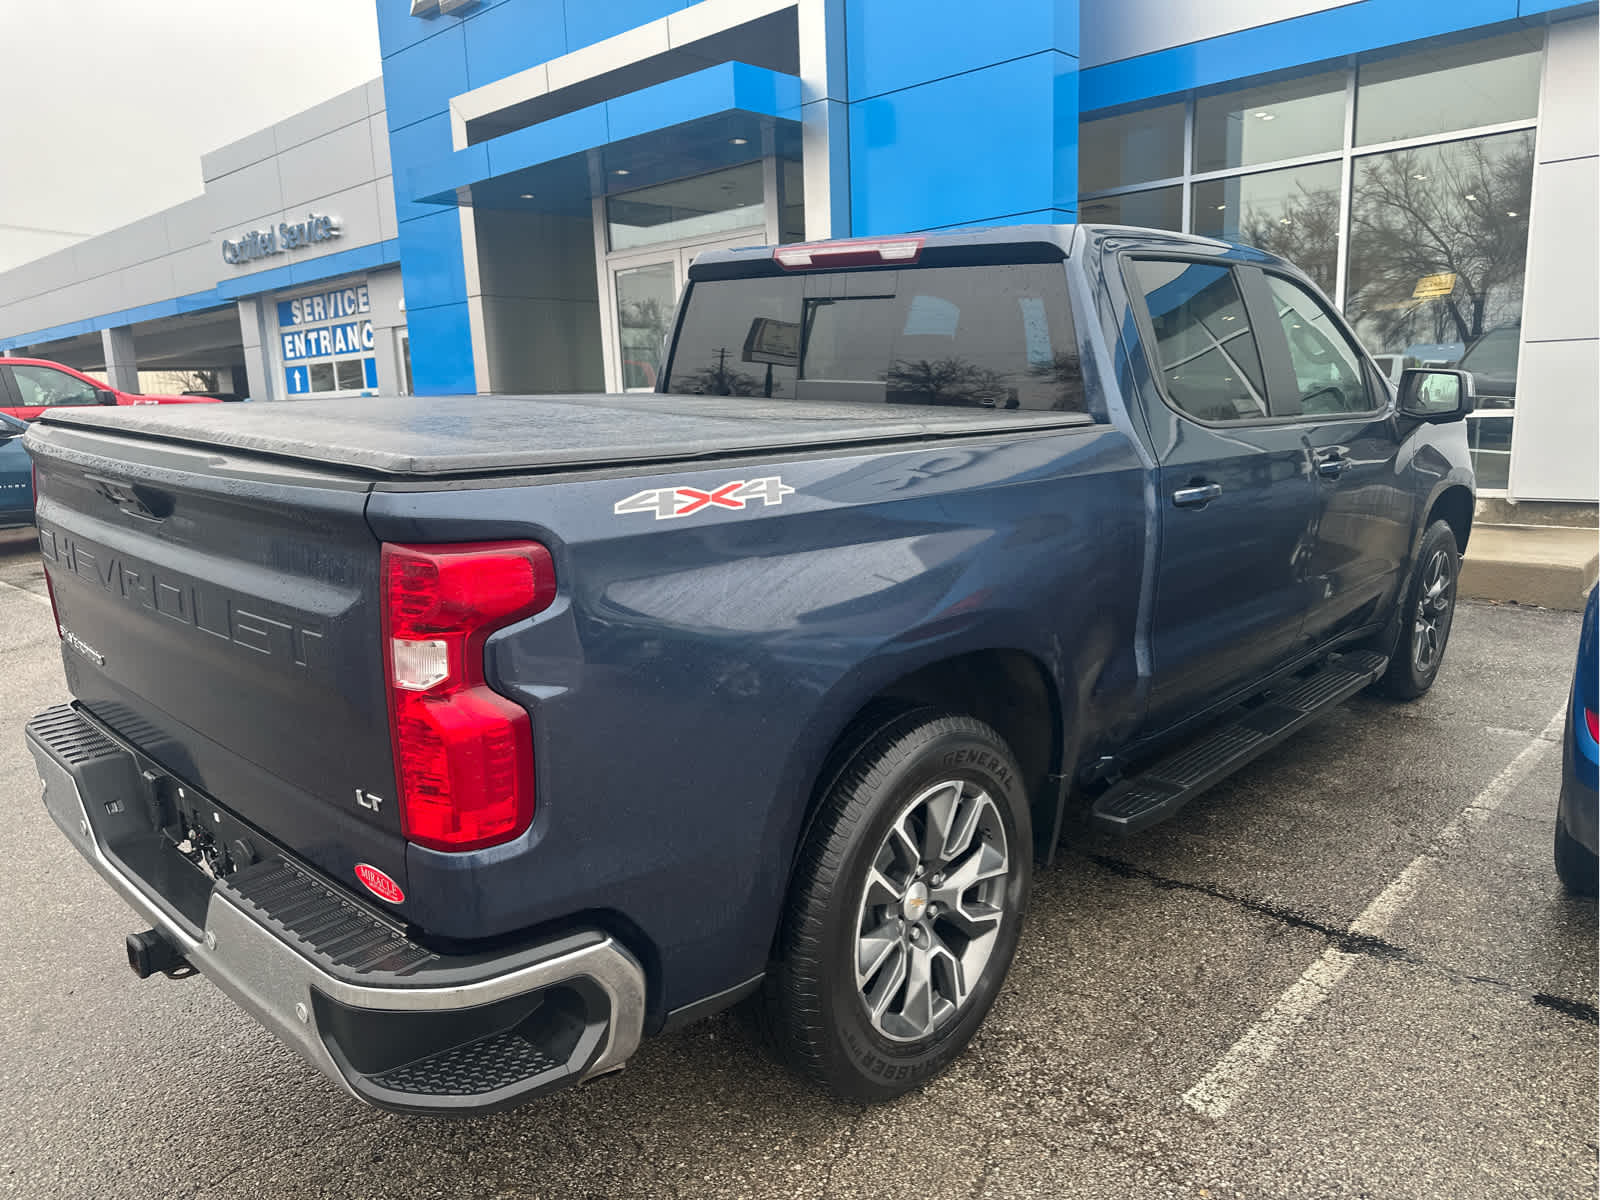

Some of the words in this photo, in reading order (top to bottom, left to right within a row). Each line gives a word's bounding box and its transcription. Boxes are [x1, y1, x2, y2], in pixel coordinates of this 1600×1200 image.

[222, 224, 277, 265] Certified
[280, 213, 331, 249] Service
[291, 286, 371, 325] SERVICE
[39, 529, 324, 667] CHEVROLET
[943, 749, 1013, 791] GENERAL
[355, 788, 383, 813] LT
[359, 866, 399, 896] MIRACLE
